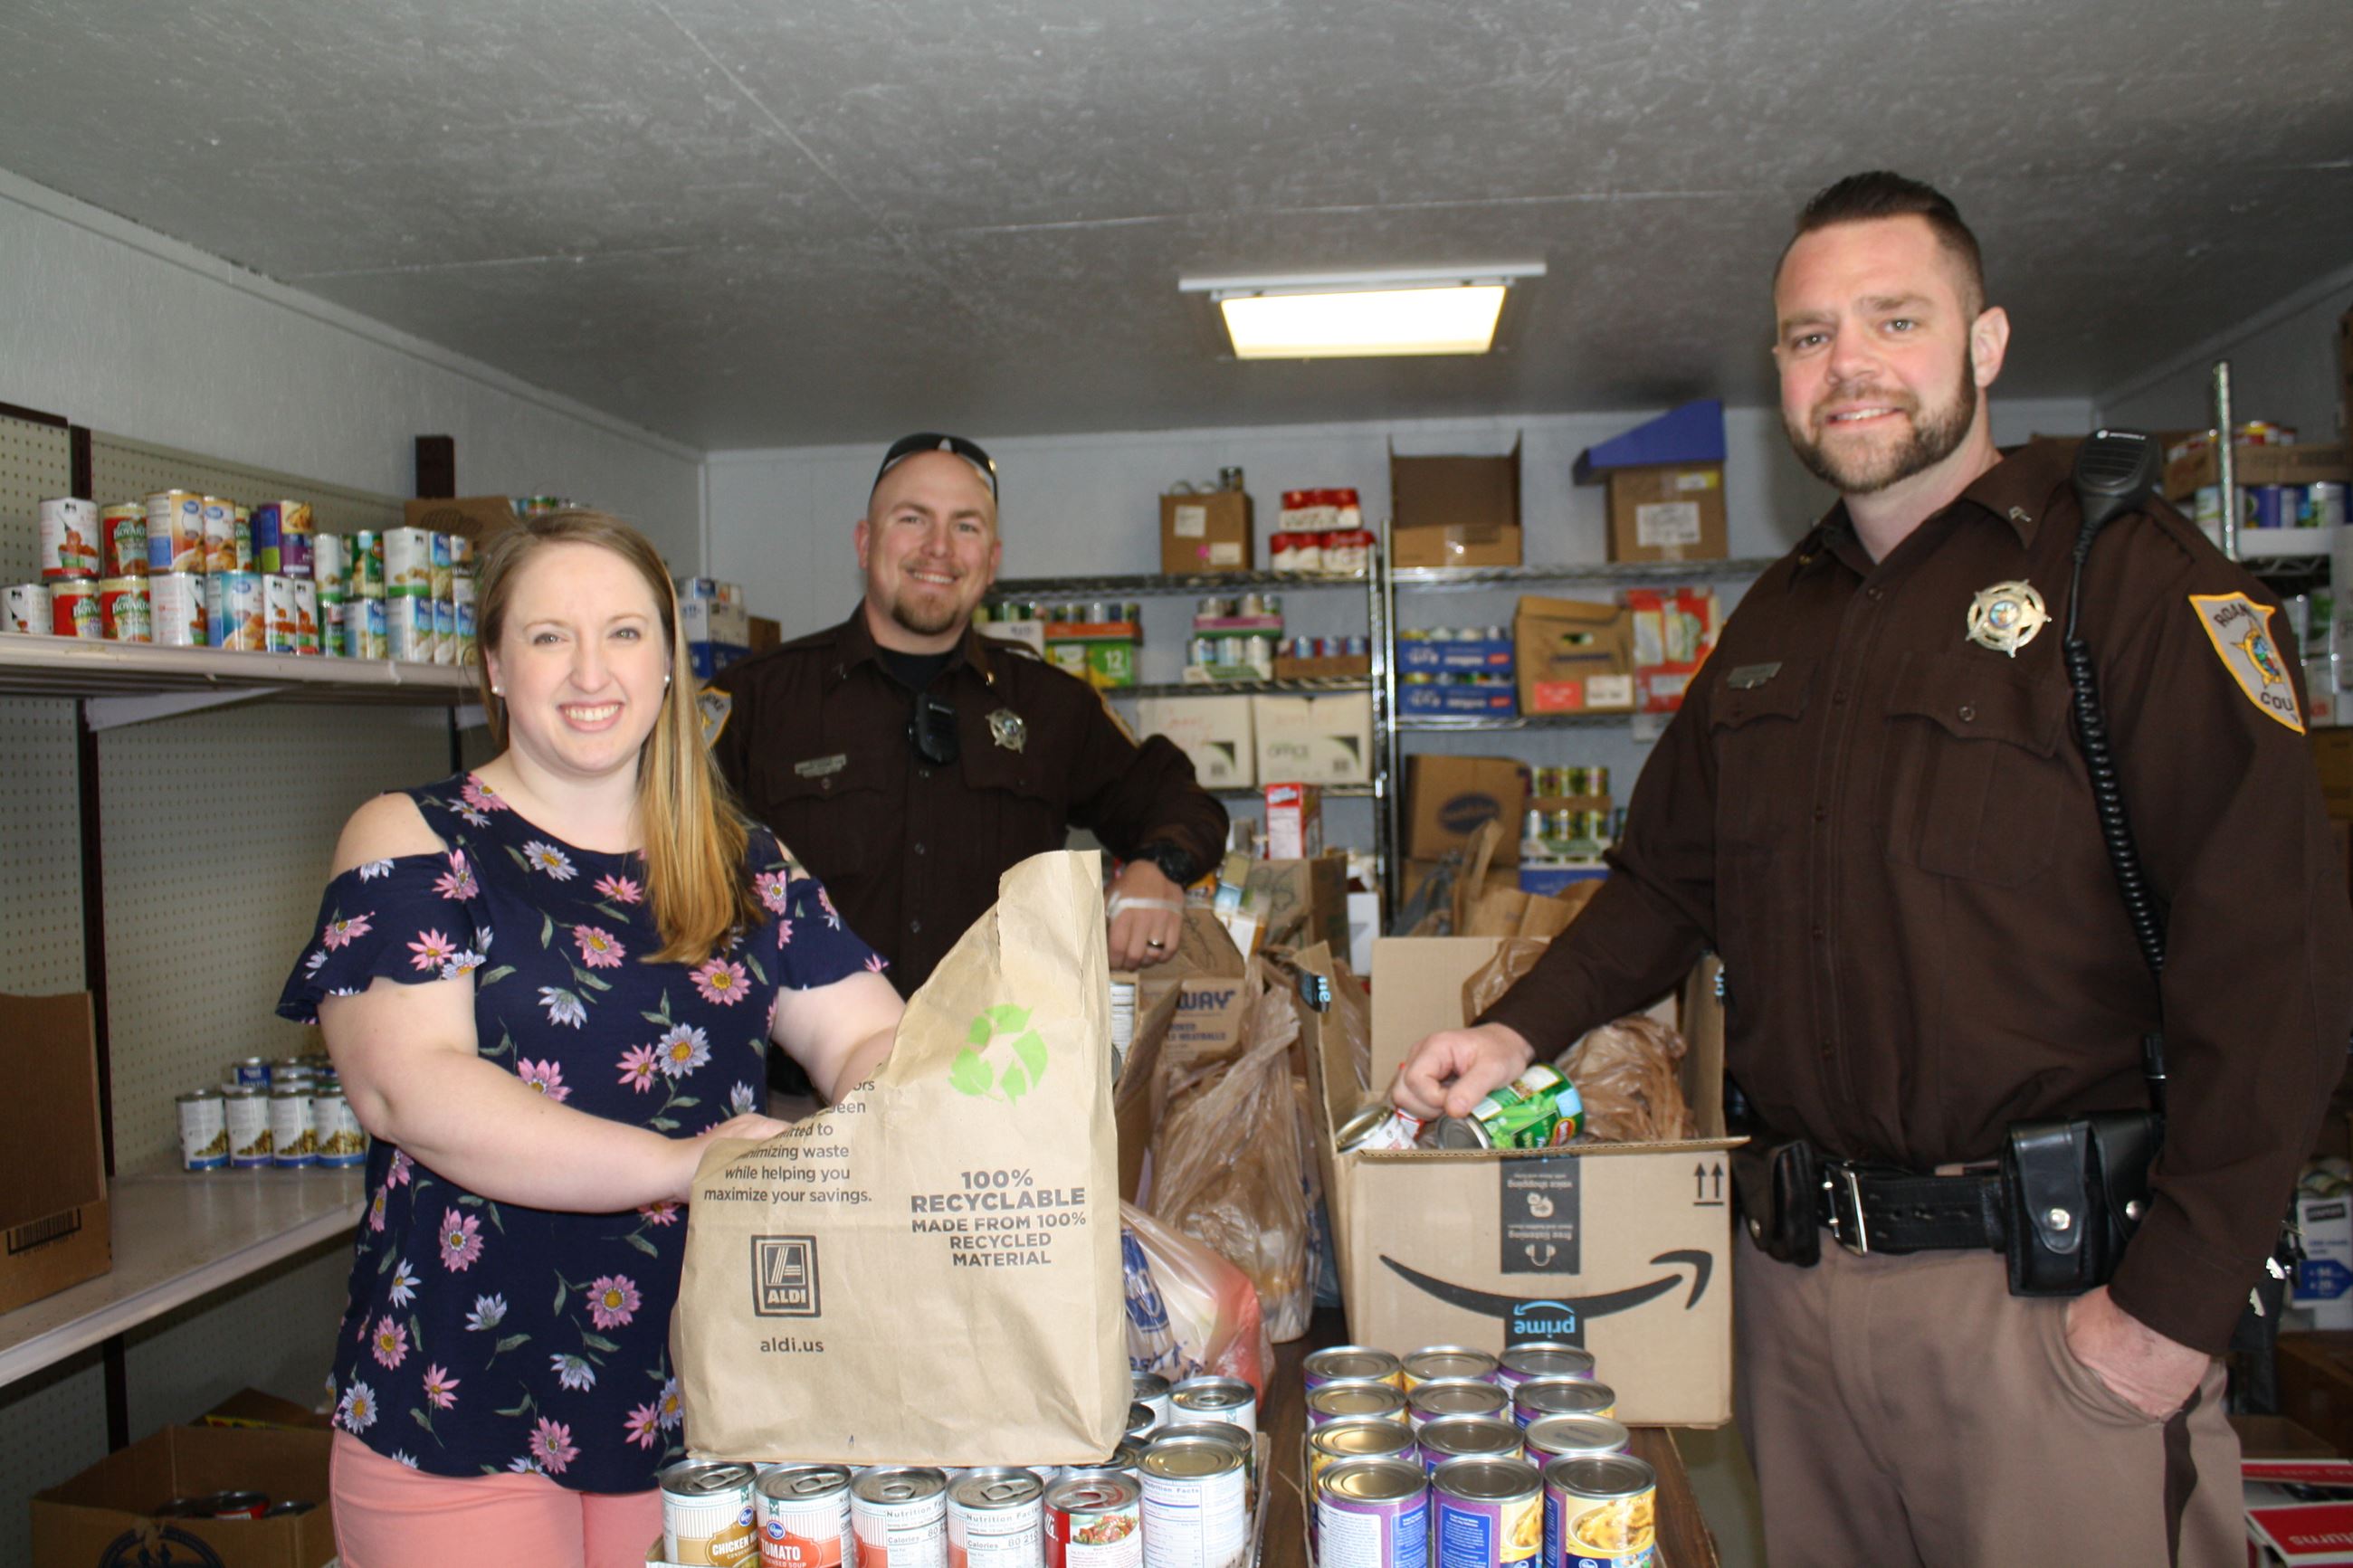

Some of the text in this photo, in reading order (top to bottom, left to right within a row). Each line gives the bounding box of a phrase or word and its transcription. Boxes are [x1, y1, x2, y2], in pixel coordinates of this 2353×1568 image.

[2214, 603, 2250, 628] ROAN
[2260, 692, 2294, 712] COU
[1177, 991, 1228, 1011] WAY
[816, 1122, 834, 1136] to
[803, 1145, 849, 1158] waste
[725, 1166, 851, 1183] while helping you
[961, 1168, 1034, 1190] 100%
[703, 1187, 872, 1205] maximize your savings.
[910, 1187, 1086, 1213] RECYCLABLE
[912, 1212, 1086, 1233] MADE FROM 100%
[950, 1232, 1053, 1250] RECYCLED
[953, 1250, 1053, 1267] MATERIAL
[767, 1289, 806, 1304] ALDI
[1514, 1316, 1576, 1339] prime
[760, 1337, 824, 1353] aldi.us
[1176, 1487, 1200, 1495] Facts
[886, 1506, 931, 1518] Nutrition
[967, 1513, 1013, 1524] Nutrition
[887, 1535, 919, 1544] Calories
[928, 1526, 939, 1538] 80
[967, 1540, 999, 1550] Calories
[1007, 1537, 1021, 1547] 80
[711, 1533, 750, 1557] CHICKEN
[761, 1537, 802, 1562] TOMATO
